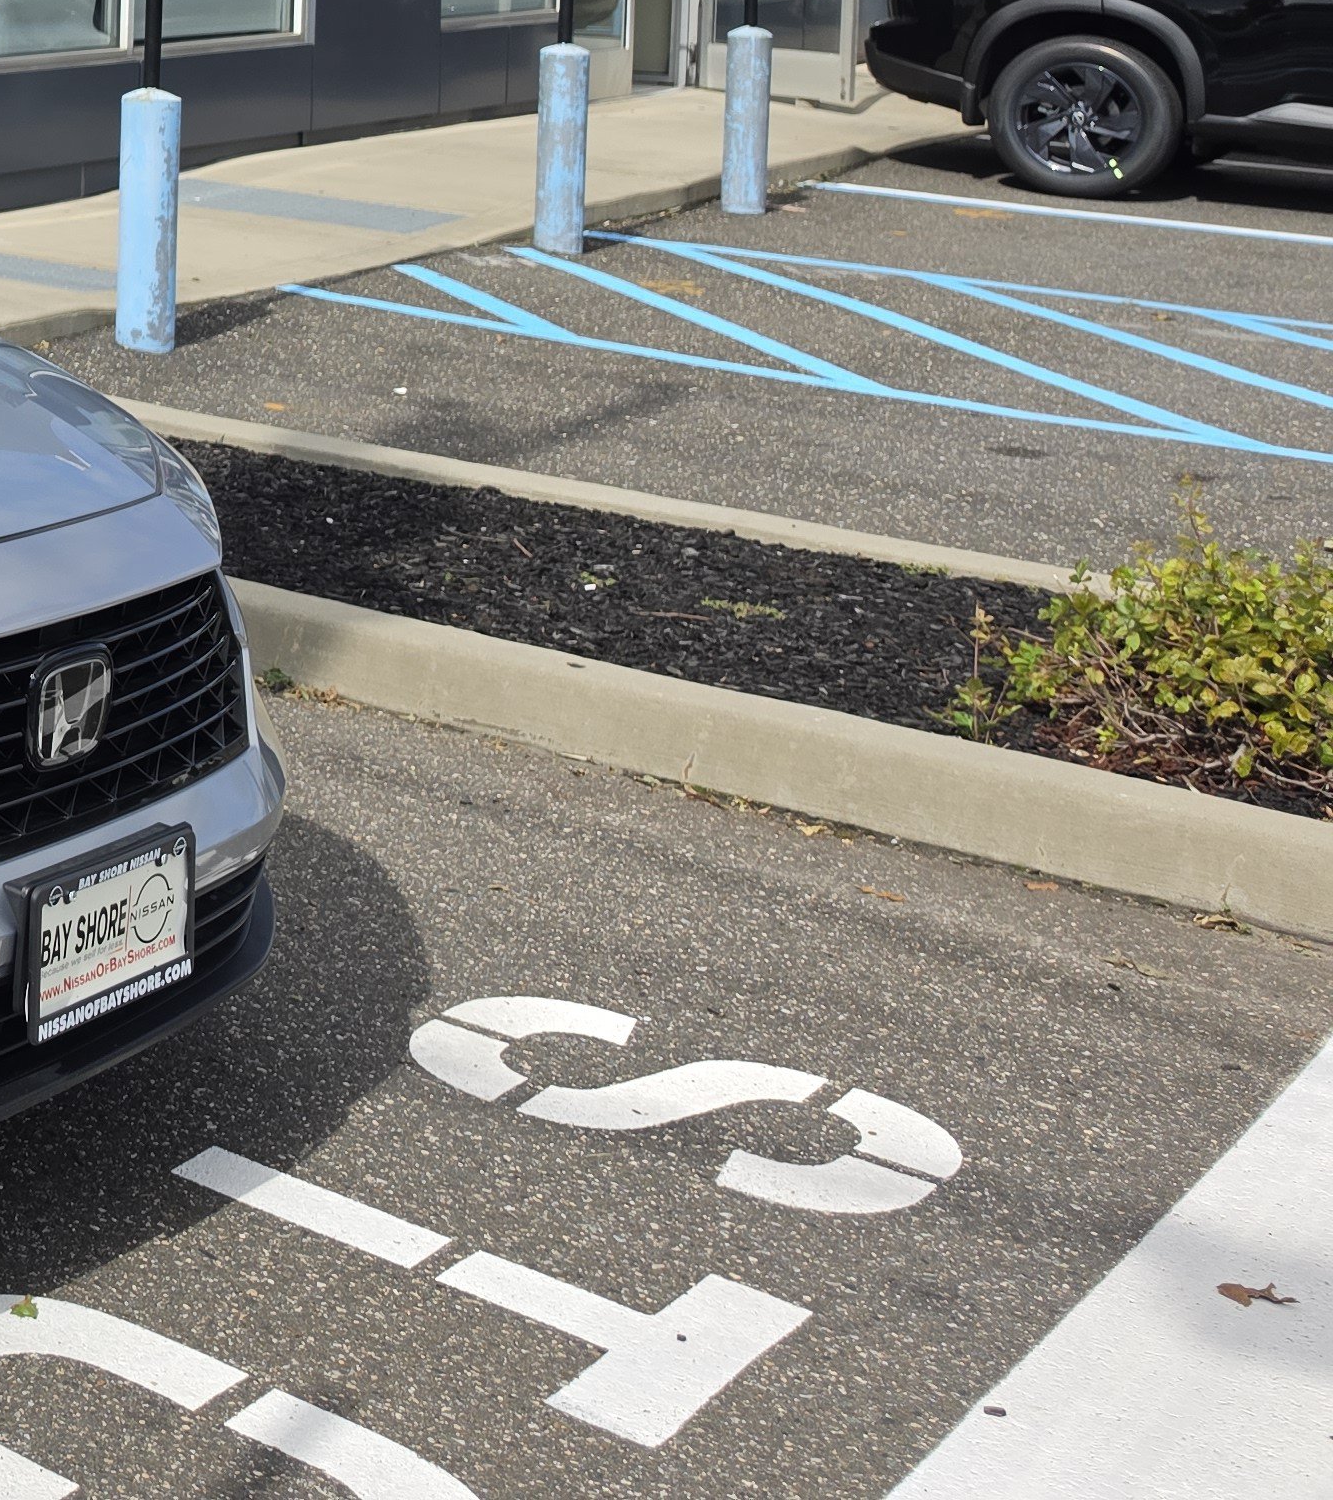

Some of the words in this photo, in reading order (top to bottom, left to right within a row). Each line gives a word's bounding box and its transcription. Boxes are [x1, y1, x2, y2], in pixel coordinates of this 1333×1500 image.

[78, 873, 98, 891] BAY
[99, 861, 129, 882] SHORE
[130, 847, 161, 871] NISSAN
[130, 894, 175, 923] NISSAN
[41, 920, 72, 969] BAY
[75, 898, 127, 954] SHORE
[41, 962, 70, 979] ecause
[97, 945, 108, 956] for
[38, 958, 192, 1043] NISSANOFBAYSHORE.COM
